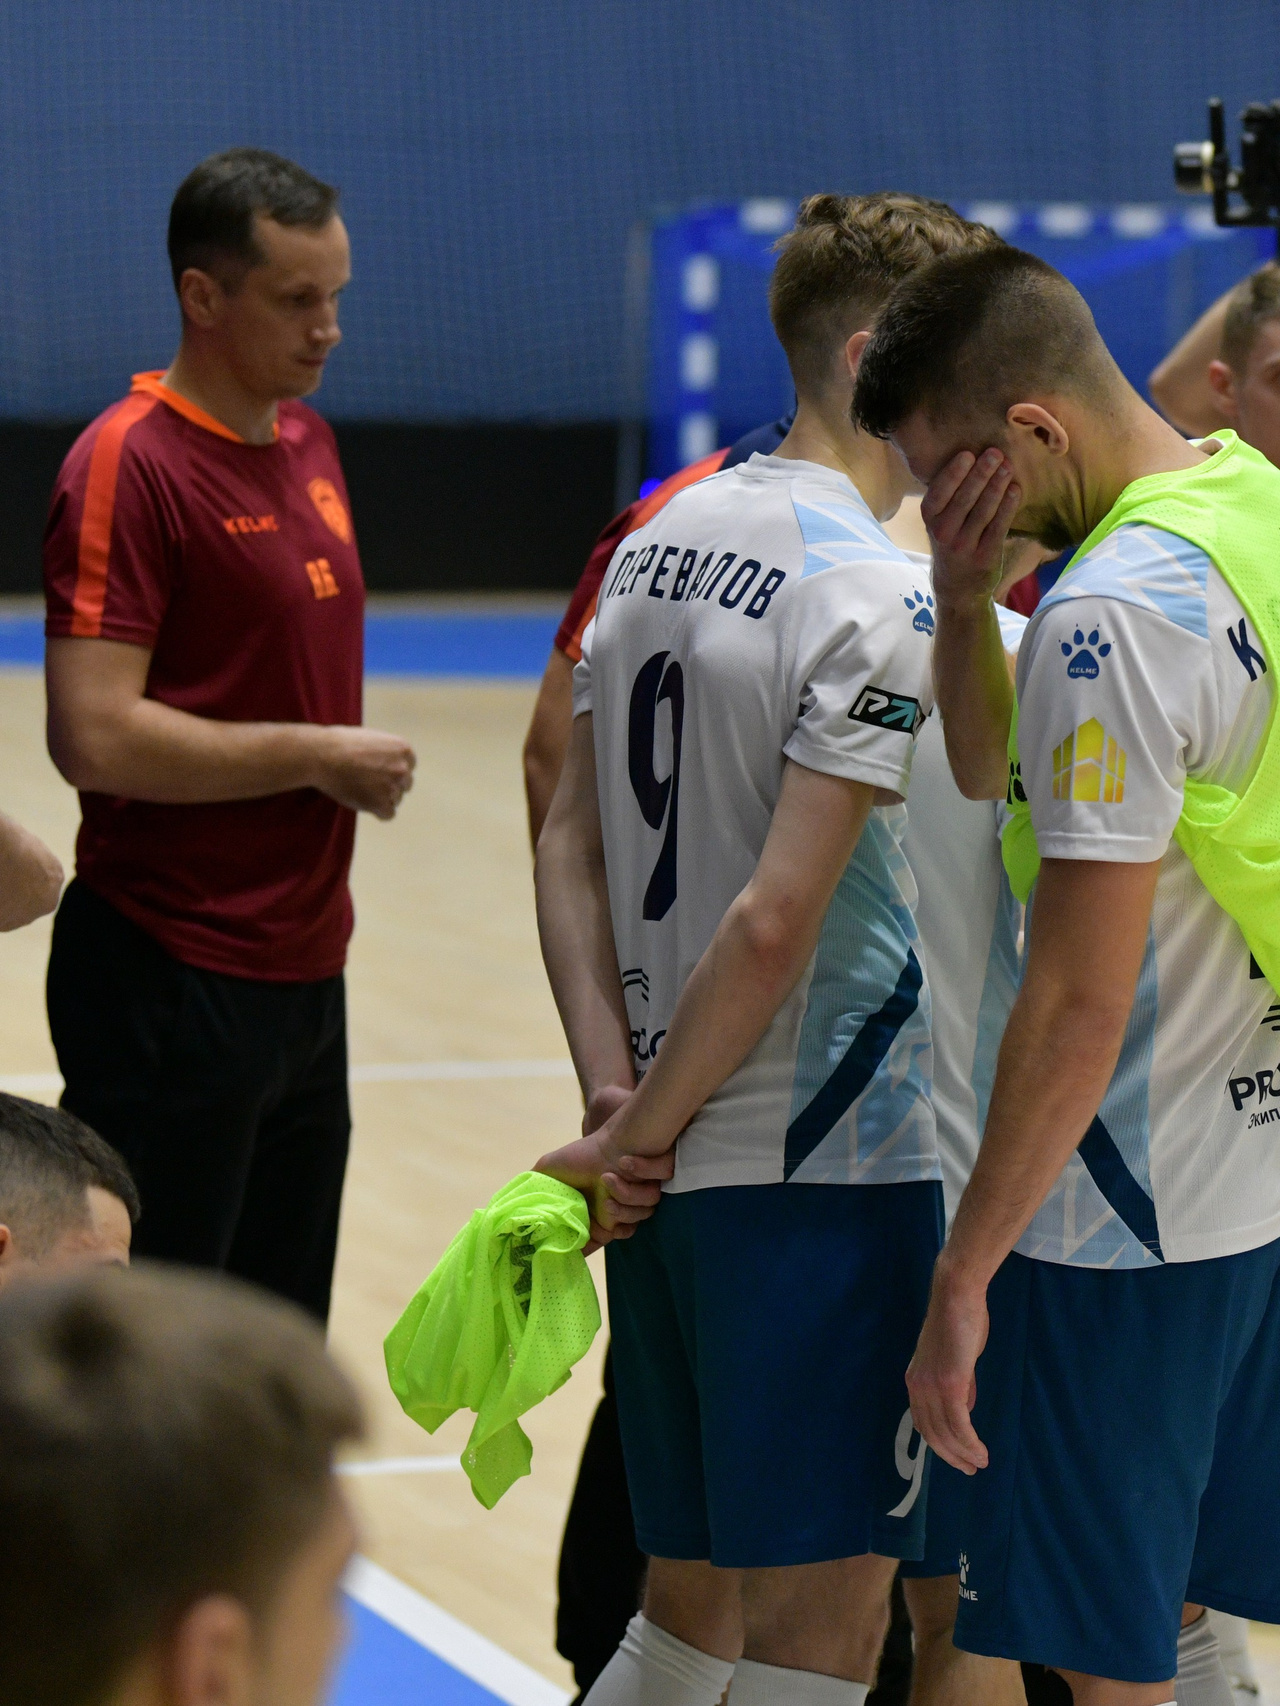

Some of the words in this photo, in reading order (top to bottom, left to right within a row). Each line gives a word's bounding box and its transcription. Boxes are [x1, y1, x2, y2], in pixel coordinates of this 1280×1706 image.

[606, 543, 787, 620] ПЕРЕВАЛОВ
[1069, 667, 1098, 675] KELME
[628, 650, 684, 921] 9
[886, 1406, 928, 1518] 9
